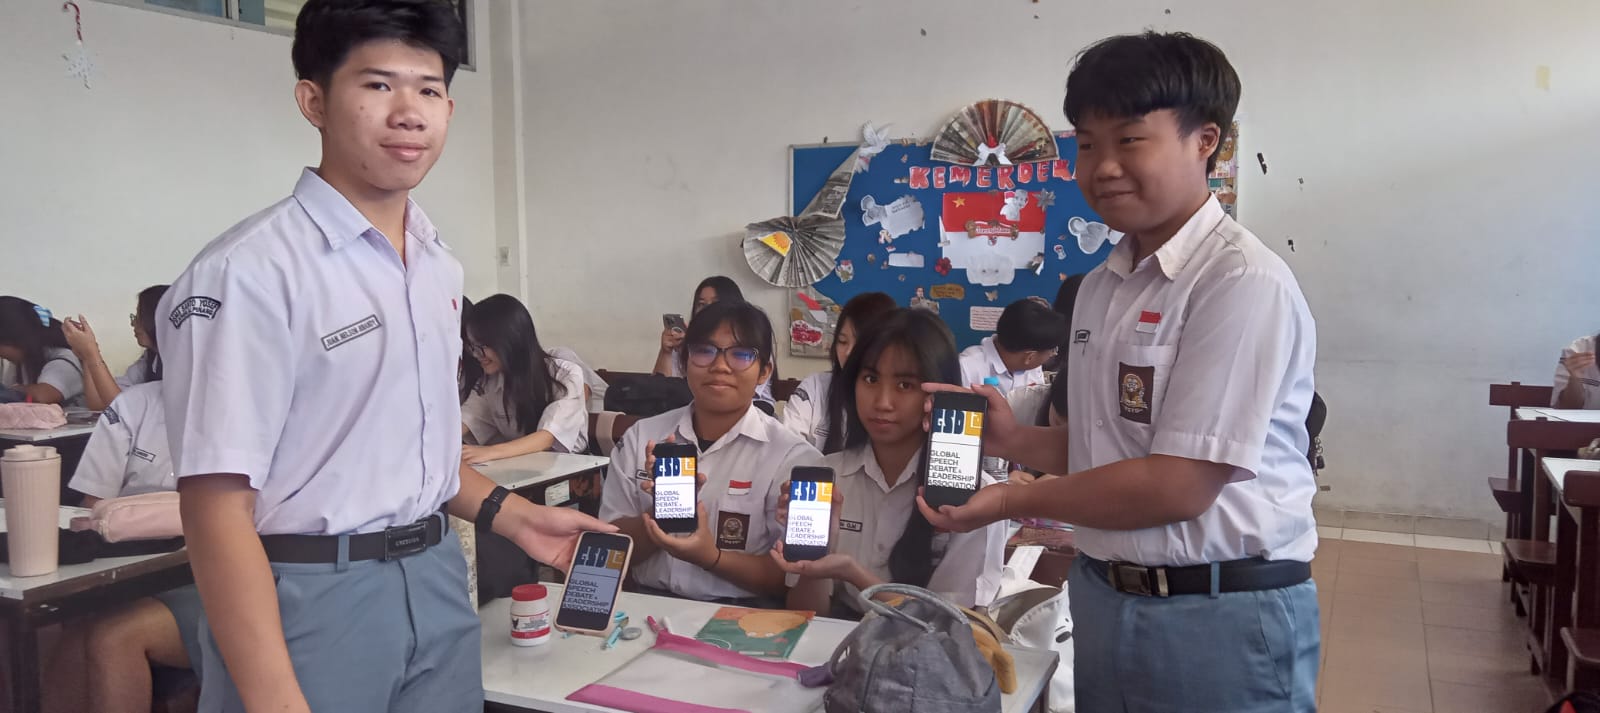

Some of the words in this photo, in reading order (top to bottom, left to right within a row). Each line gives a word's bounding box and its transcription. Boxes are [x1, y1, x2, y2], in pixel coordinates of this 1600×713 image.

[909, 159, 1077, 190] KEMERDEK
[930, 450, 960, 459] GLOBAL
[929, 465, 957, 473] DEBATE
[928, 472, 975, 482] LEADERSHIP
[928, 480, 977, 490] ASSOCIATION
[570, 579, 598, 588] GLOBAL
[568, 585, 597, 593] SPEECH
[567, 591, 593, 599] DEBATE
[564, 597, 609, 606] LEADERSHIP
